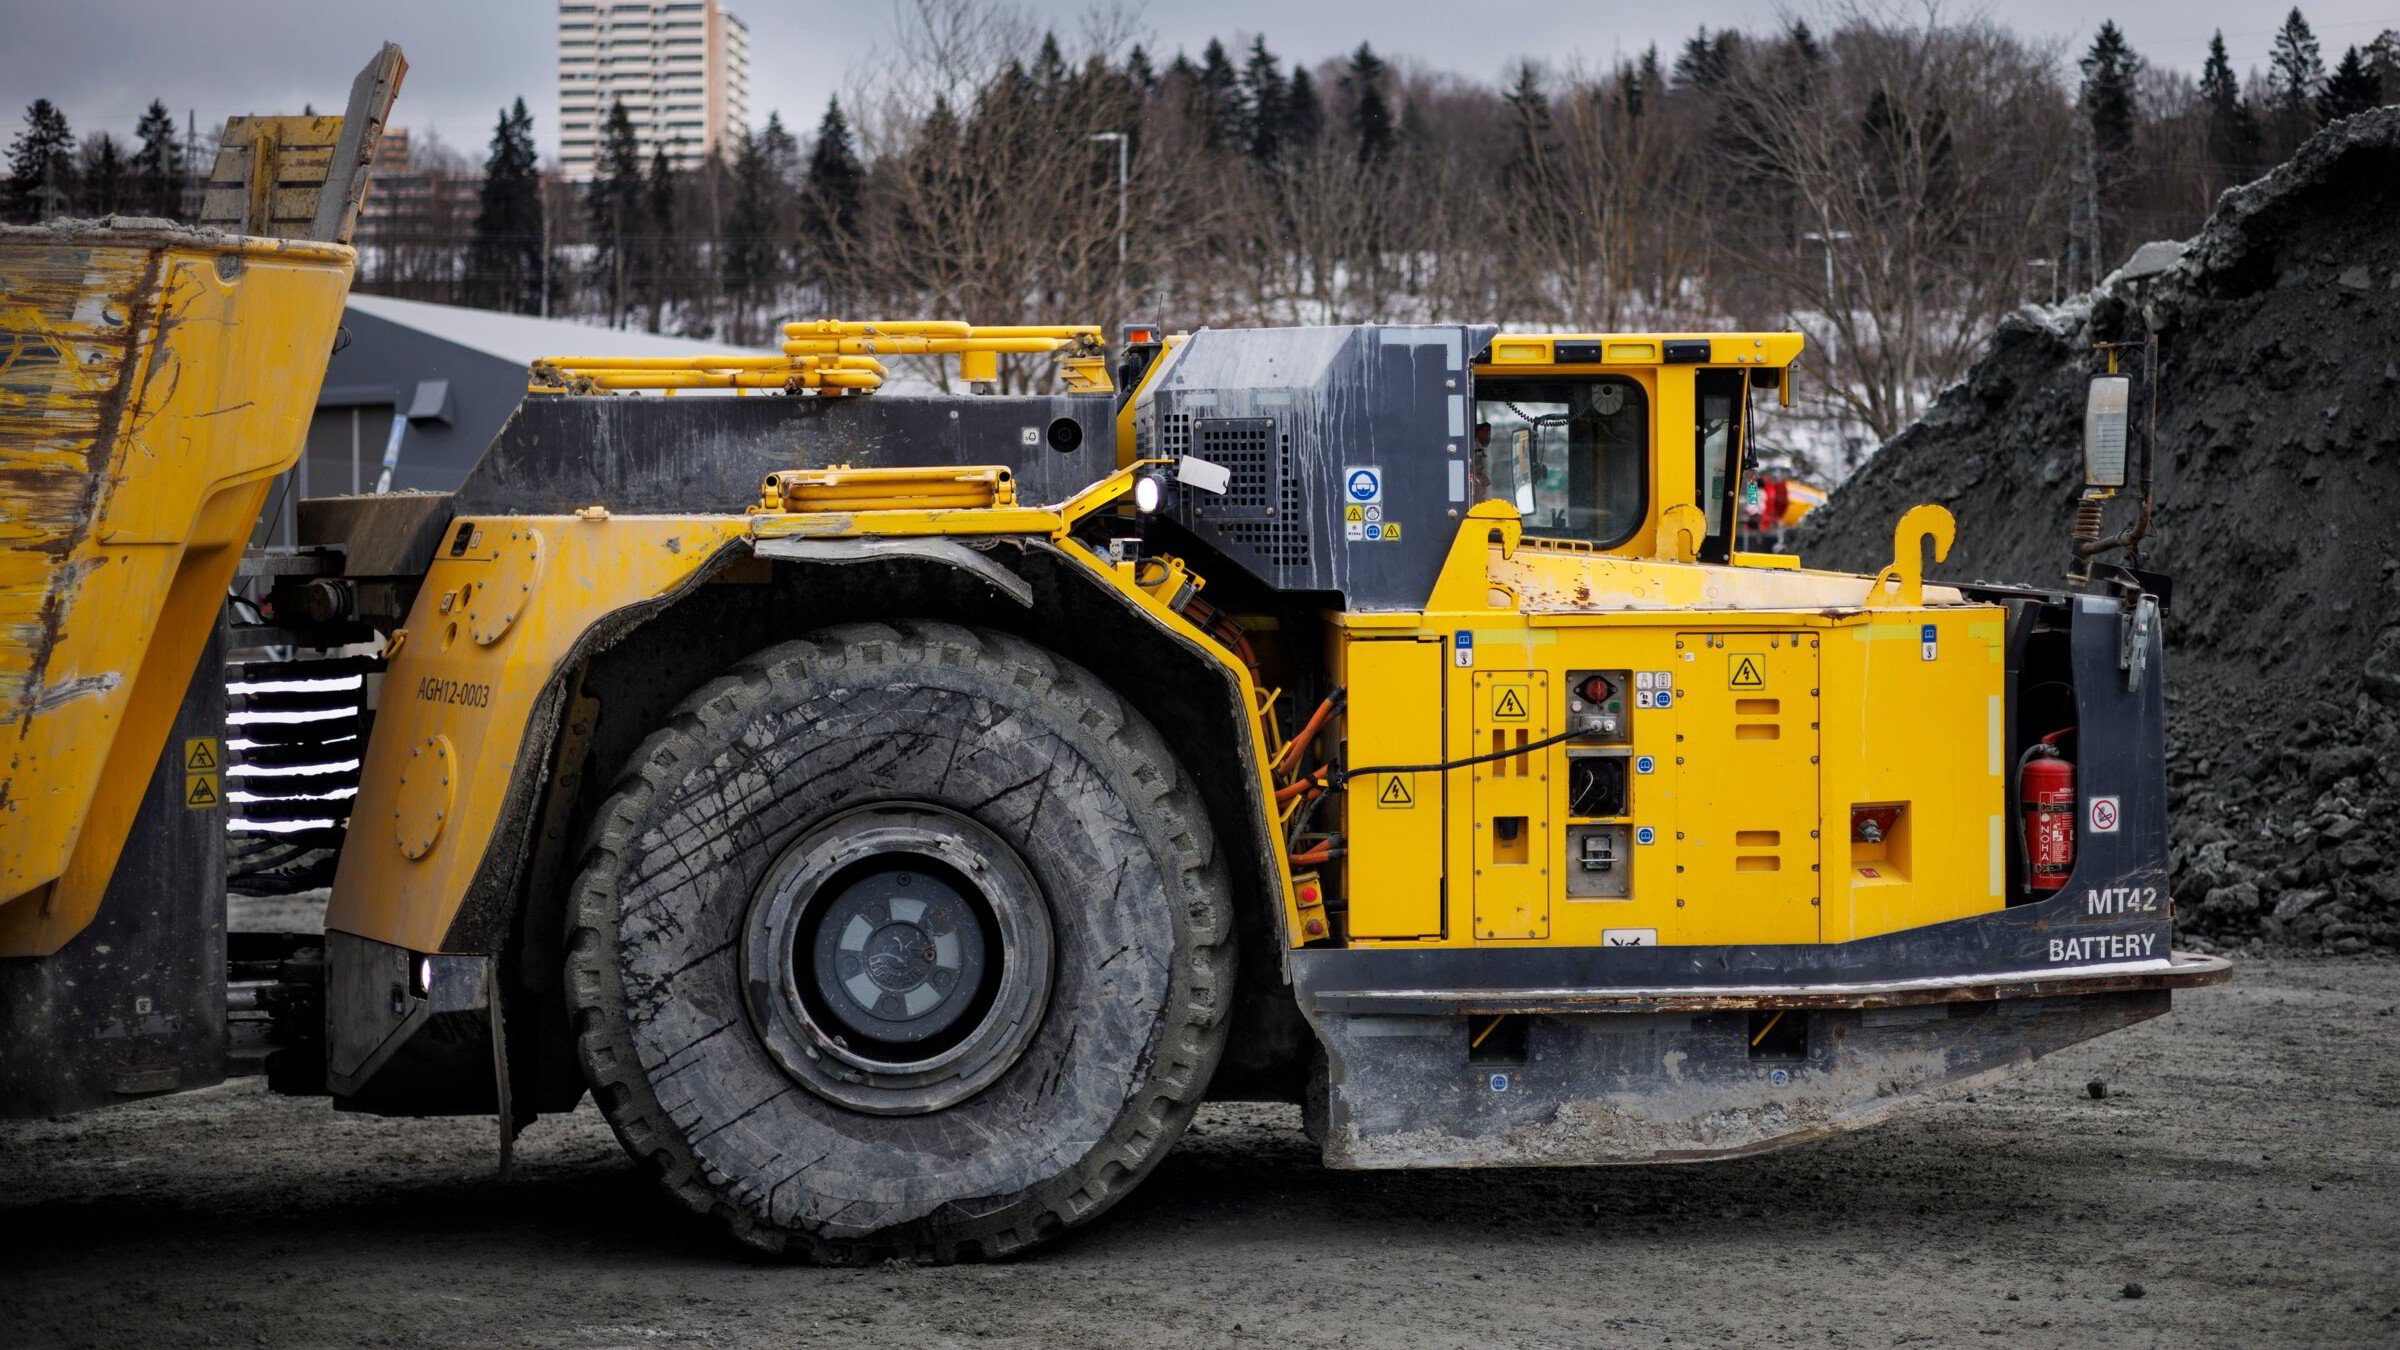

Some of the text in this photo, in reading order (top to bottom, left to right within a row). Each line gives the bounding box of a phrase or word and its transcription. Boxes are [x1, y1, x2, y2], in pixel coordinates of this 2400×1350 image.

[416, 676, 490, 708] AGH12-0003
[2040, 825, 2050, 861] NOHA
[2088, 886, 2157, 915] MT42
[2049, 933, 2156, 962] BATTERY
